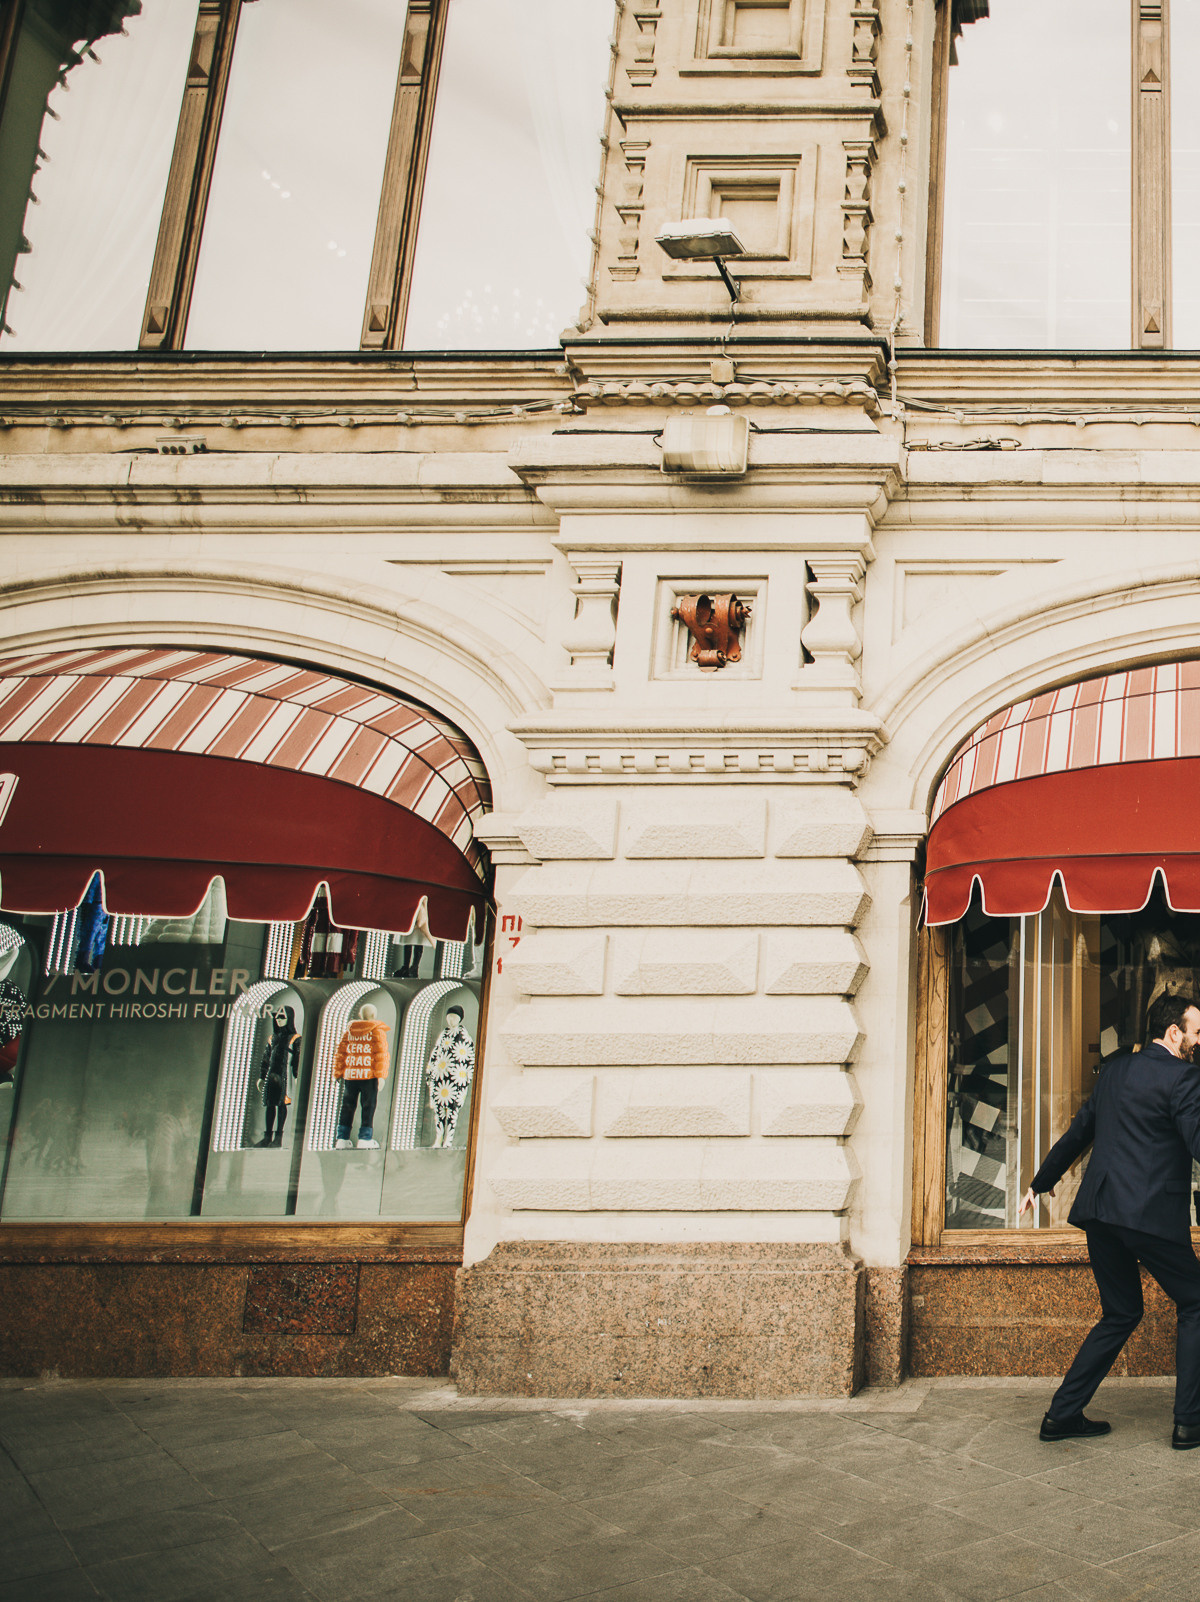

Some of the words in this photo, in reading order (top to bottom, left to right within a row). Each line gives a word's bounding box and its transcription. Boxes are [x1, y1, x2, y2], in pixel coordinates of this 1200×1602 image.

[71, 968, 250, 996] MONCLER
[0, 1003, 105, 1019] FRAGMENT
[110, 1003, 188, 1019] HIROSHI
[194, 1003, 288, 1019] FUJIARA
